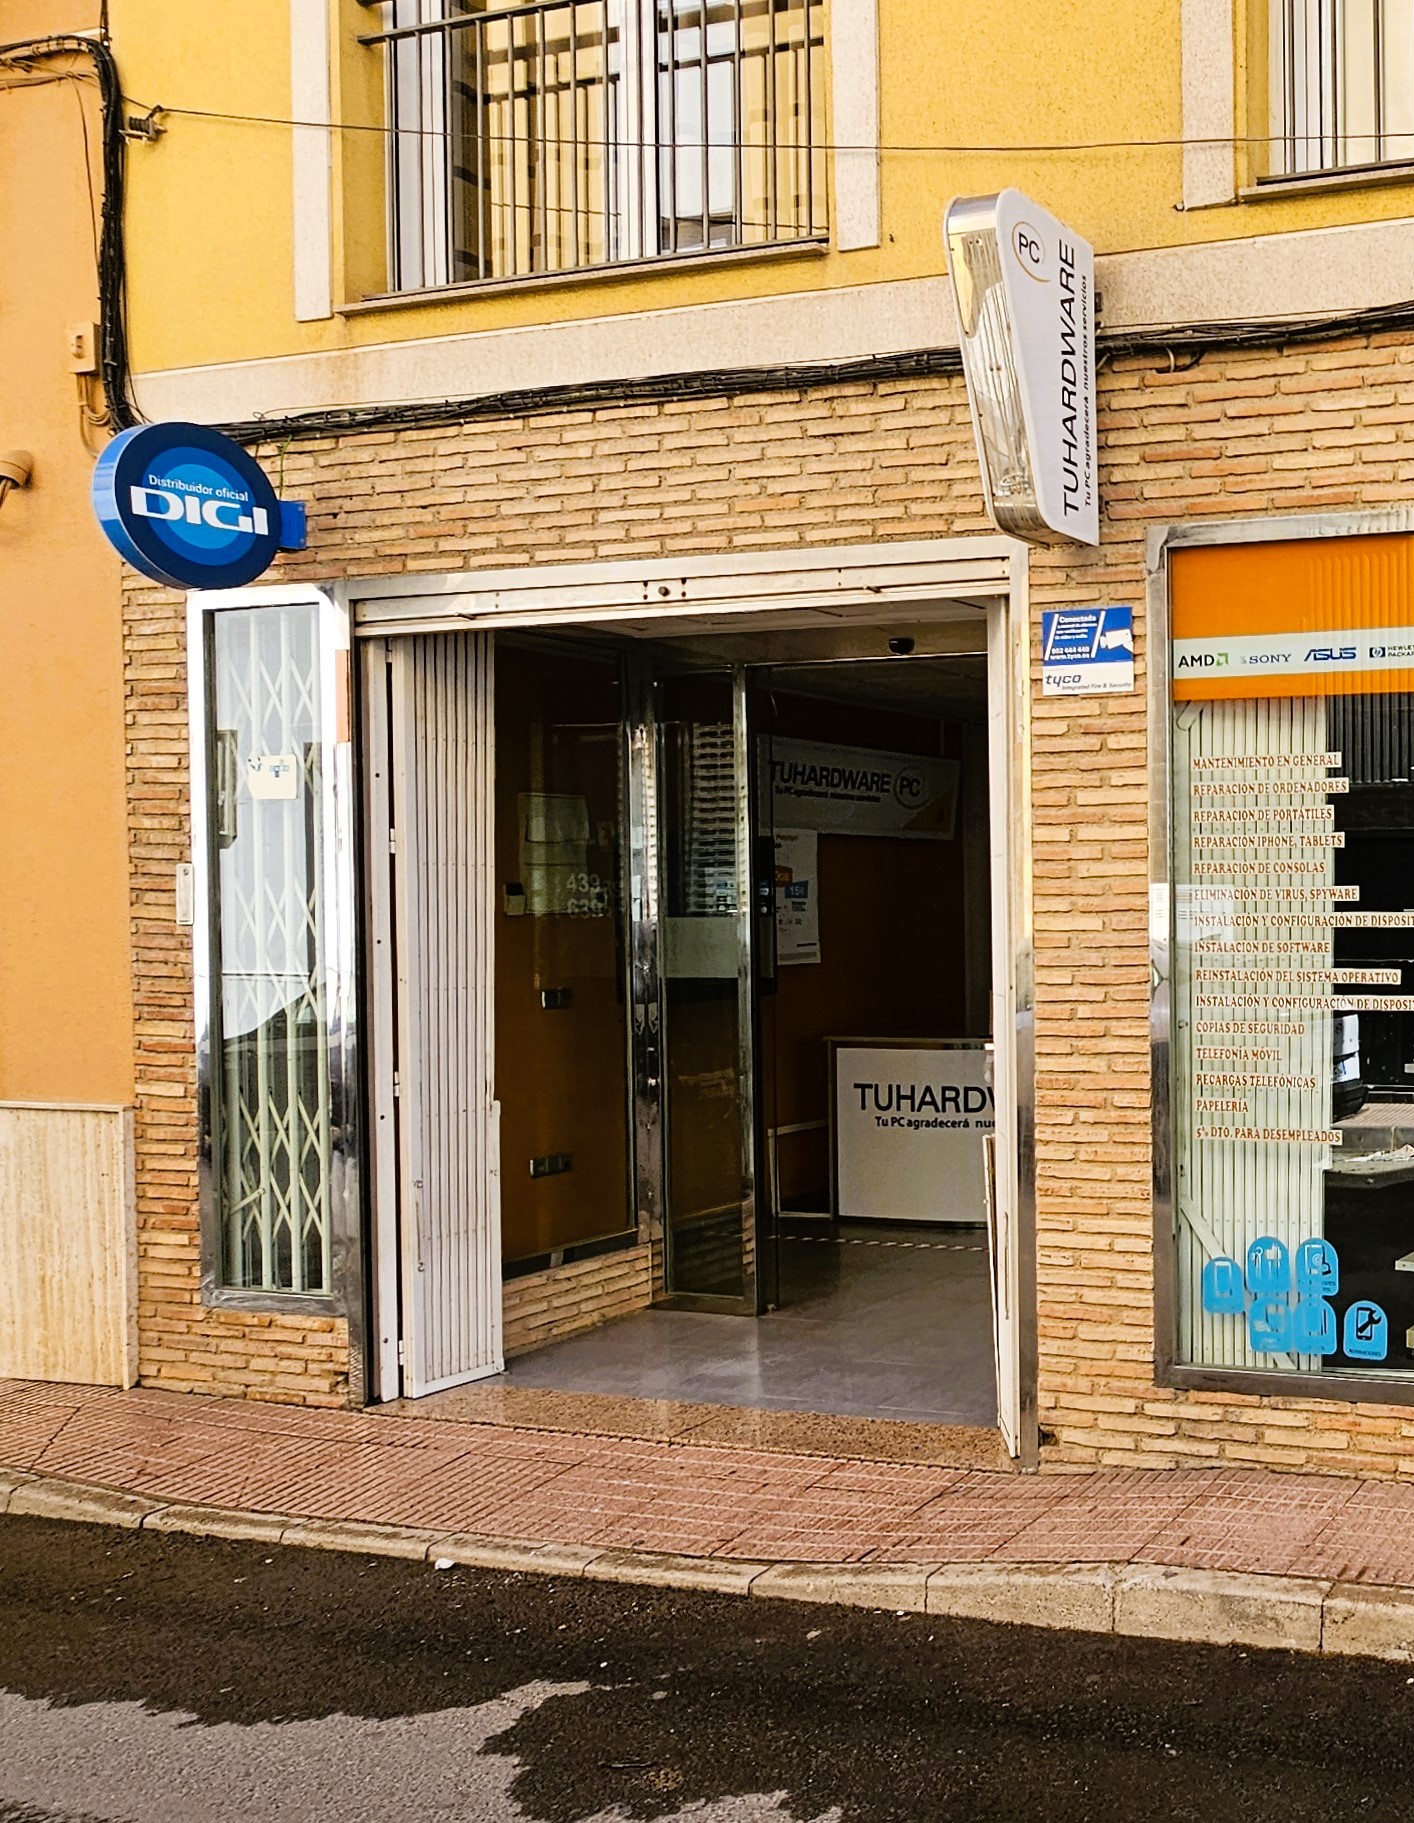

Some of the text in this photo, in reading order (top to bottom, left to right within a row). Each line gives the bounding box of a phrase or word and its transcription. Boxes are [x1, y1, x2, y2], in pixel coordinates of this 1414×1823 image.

[1018, 231, 1040, 264] PC
[1058, 238, 1080, 517] TUHARDWARE
[148, 474, 249, 502] Distribuidor oficial
[130, 485, 269, 537] DIGI
[1249, 653, 1292, 665] SONY
[1304, 646, 1358, 662] ASUS
[1178, 654, 1216, 669] AMD
[1045, 674, 1082, 687] tyco
[1193, 754, 1340, 769] MANTENIMIENTO EN GENERAL
[899, 776, 922, 798] PC
[1258, 783, 1270, 794] DE
[1273, 781, 1347, 794] ORDENADORES
[1258, 809, 1270, 820] DE
[1257, 835, 1297, 849] IPHONE,
[1299, 834, 1342, 847] TABLETS
[1258, 862, 1270, 874] DE
[1273, 861, 1325, 873] CONSOLAS
[1259, 889, 1272, 900] DE
[1275, 888, 1308, 902] VIRUS,
[1309, 888, 1358, 900] SPYWARE
[1262, 915, 1269, 926] Y
[1355, 915, 1368, 926] DE
[1261, 942, 1274, 953] DE
[1277, 942, 1330, 953] SOFTWARE
[1275, 971, 1295, 982] DEL
[1296, 971, 1338, 983] SISTEMA
[1341, 972, 1399, 984] OPERATIVO
[1263, 997, 1270, 1008] Y
[1357, 998, 1370, 1010] DE
[1196, 1022, 1305, 1035] COPIAS DE SEGURIDAD
[1196, 1045, 1282, 1061] TELEFONÍA MÓVIL
[1196, 1073, 1316, 1088] RECARGAS TELEFÓNICAS
[853, 1083, 994, 1114] TUHARD
[1196, 1098, 1249, 1112] PAPELERÍA
[875, 1116, 888, 1127] Tu
[891, 1117, 905, 1127] PC
[906, 1117, 970, 1130] agradecerá
[1196, 1127, 1341, 1142] 5% DTO. PARA DESEMPLEADOS
